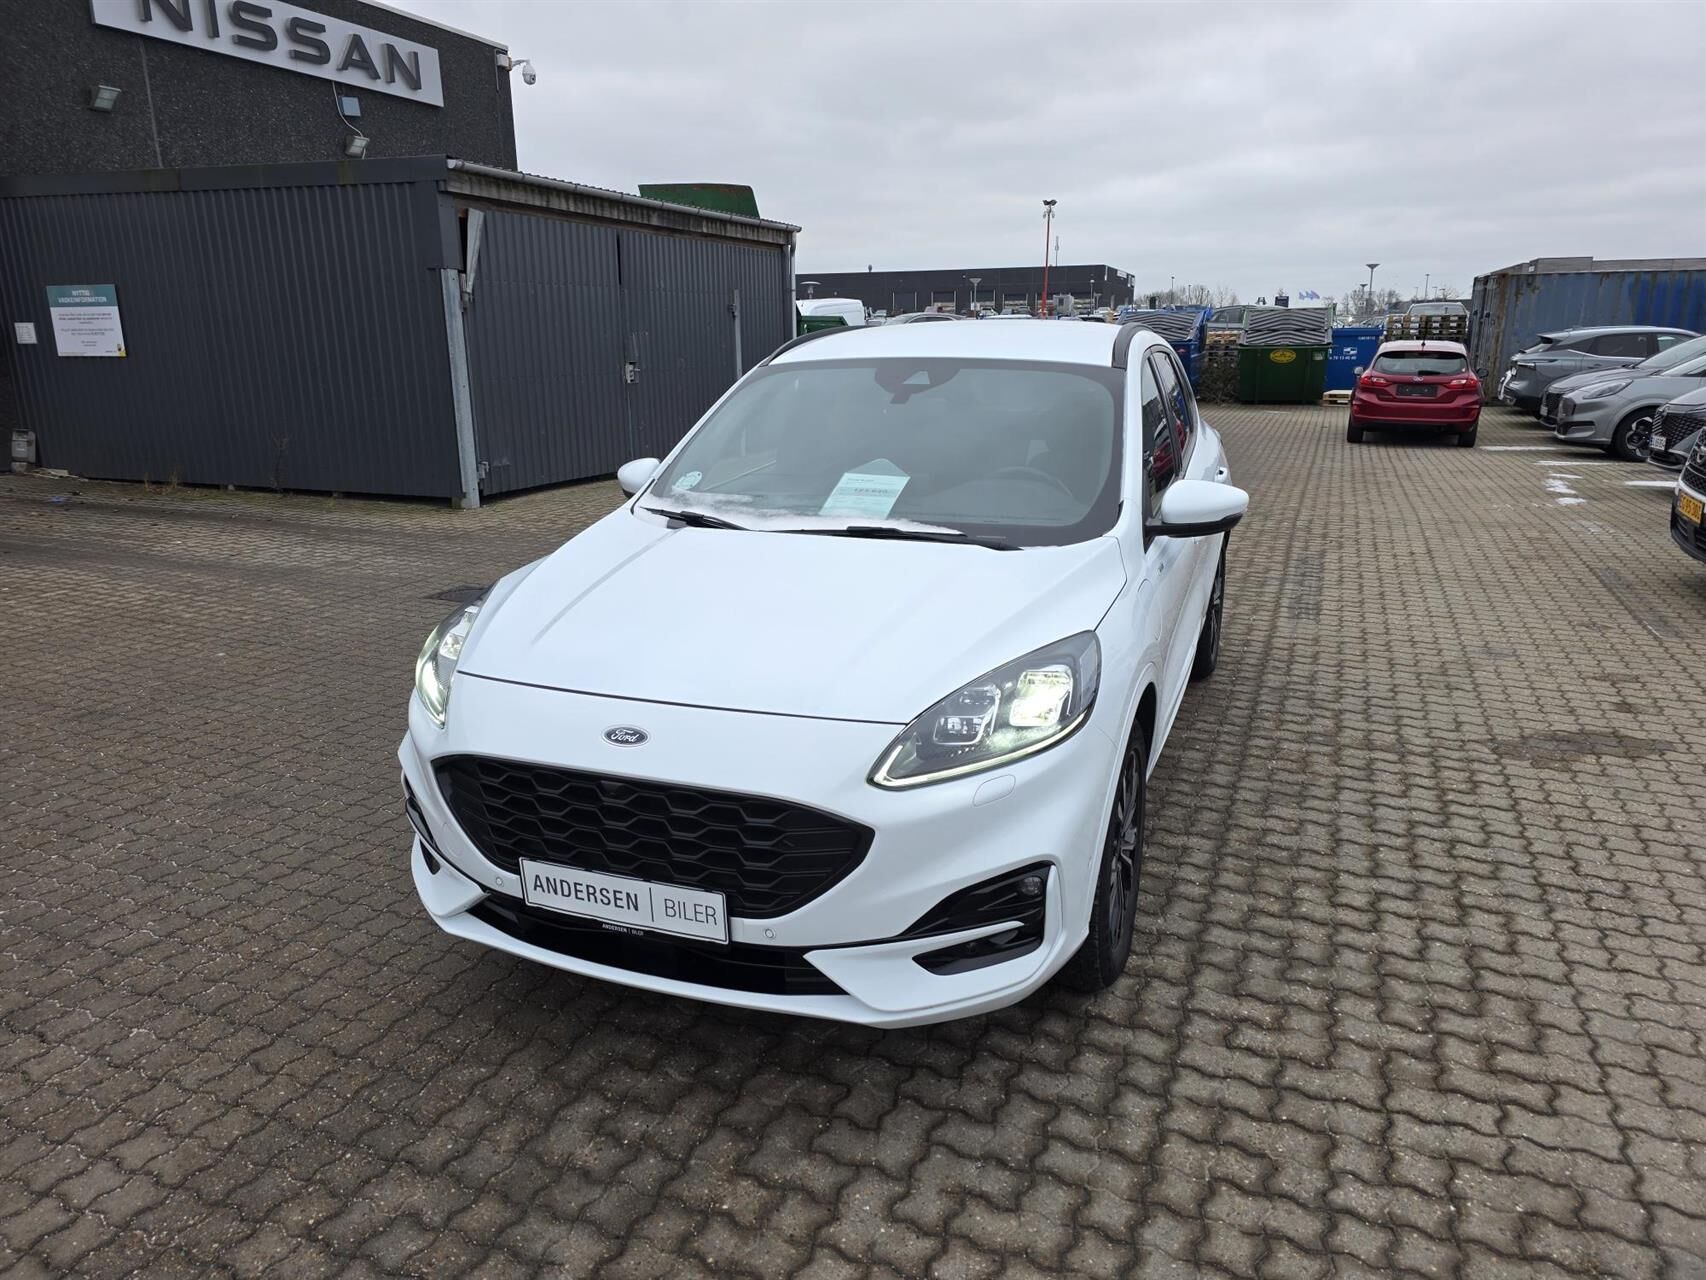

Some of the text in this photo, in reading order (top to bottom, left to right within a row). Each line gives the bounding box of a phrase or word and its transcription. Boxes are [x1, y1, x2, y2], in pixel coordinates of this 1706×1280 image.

[139, 0, 422, 90] NISSAN
[611, 728, 640, 742] Ford
[533, 874, 717, 926] ANDERSEN BILER
[602, 923, 628, 934] ANDERSEN
